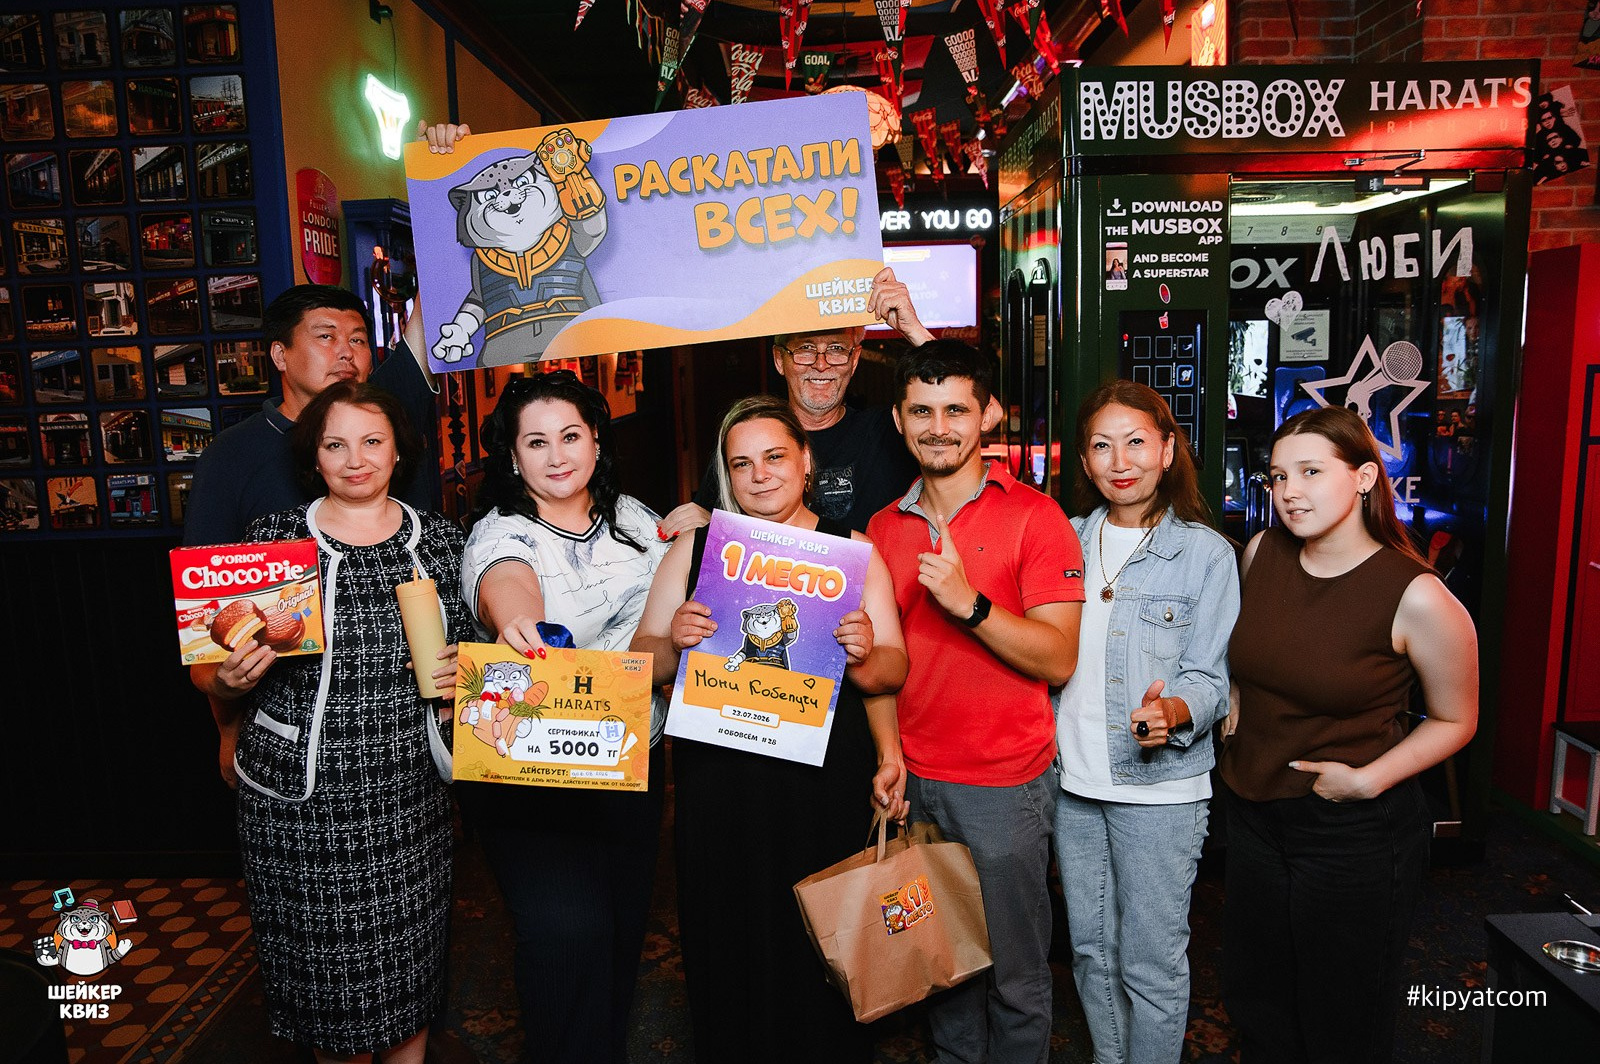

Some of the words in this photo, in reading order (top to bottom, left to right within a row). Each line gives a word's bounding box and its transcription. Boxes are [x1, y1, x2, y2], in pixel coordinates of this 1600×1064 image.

[944, 28, 975, 47] GOOOO
[804, 54, 830, 67] GOAL
[1369, 76, 1532, 111] HARAT'S
[1079, 78, 1346, 141] MUSBOX
[613, 137, 862, 202] РАСКАТАЛИ
[1131, 200, 1224, 214] DOWNLOAD
[302, 210, 338, 229] LONDON
[693, 187, 860, 251] ВСЕХ!
[920, 208, 960, 230] YOU
[965, 207, 993, 229] GO
[1105, 226, 1129, 236] THE
[1131, 218, 1223, 235] MUSBOX
[1198, 235, 1223, 246] APP
[1246, 226, 1254, 237] 7
[1281, 225, 1288, 236] 8
[1315, 225, 1323, 236] 9
[303, 228, 339, 258] PRIDE
[1132, 253, 1159, 263] AND
[1161, 252, 1209, 263] BECOME
[1132, 269, 1142, 279] A
[1143, 268, 1210, 279] SUPERSTAR
[805, 274, 874, 299] ШЕЙКЕР
[818, 295, 867, 317] КВИЗ
[750, 528, 796, 547] ШЕЙКЕР
[798, 539, 831, 555] КВИЗ
[722, 541, 745, 579] 1
[745, 557, 845, 599] МЕСТО
[277, 585, 315, 613] Original
[195, 653, 206, 661] 12
[694, 669, 740, 692] Мони
[732, 709, 771, 724] 23.07.2026
[547, 728, 600, 738] СЕРТИФИКАТ
[761, 736, 777, 746] #28
[527, 745, 541, 754] НА
[549, 740, 600, 757] 5000
[607, 750, 618, 758] ТГ
[520, 766, 569, 777] ДЕЙСТВУЕТ:
[905, 900, 934, 927] МЕСТО
